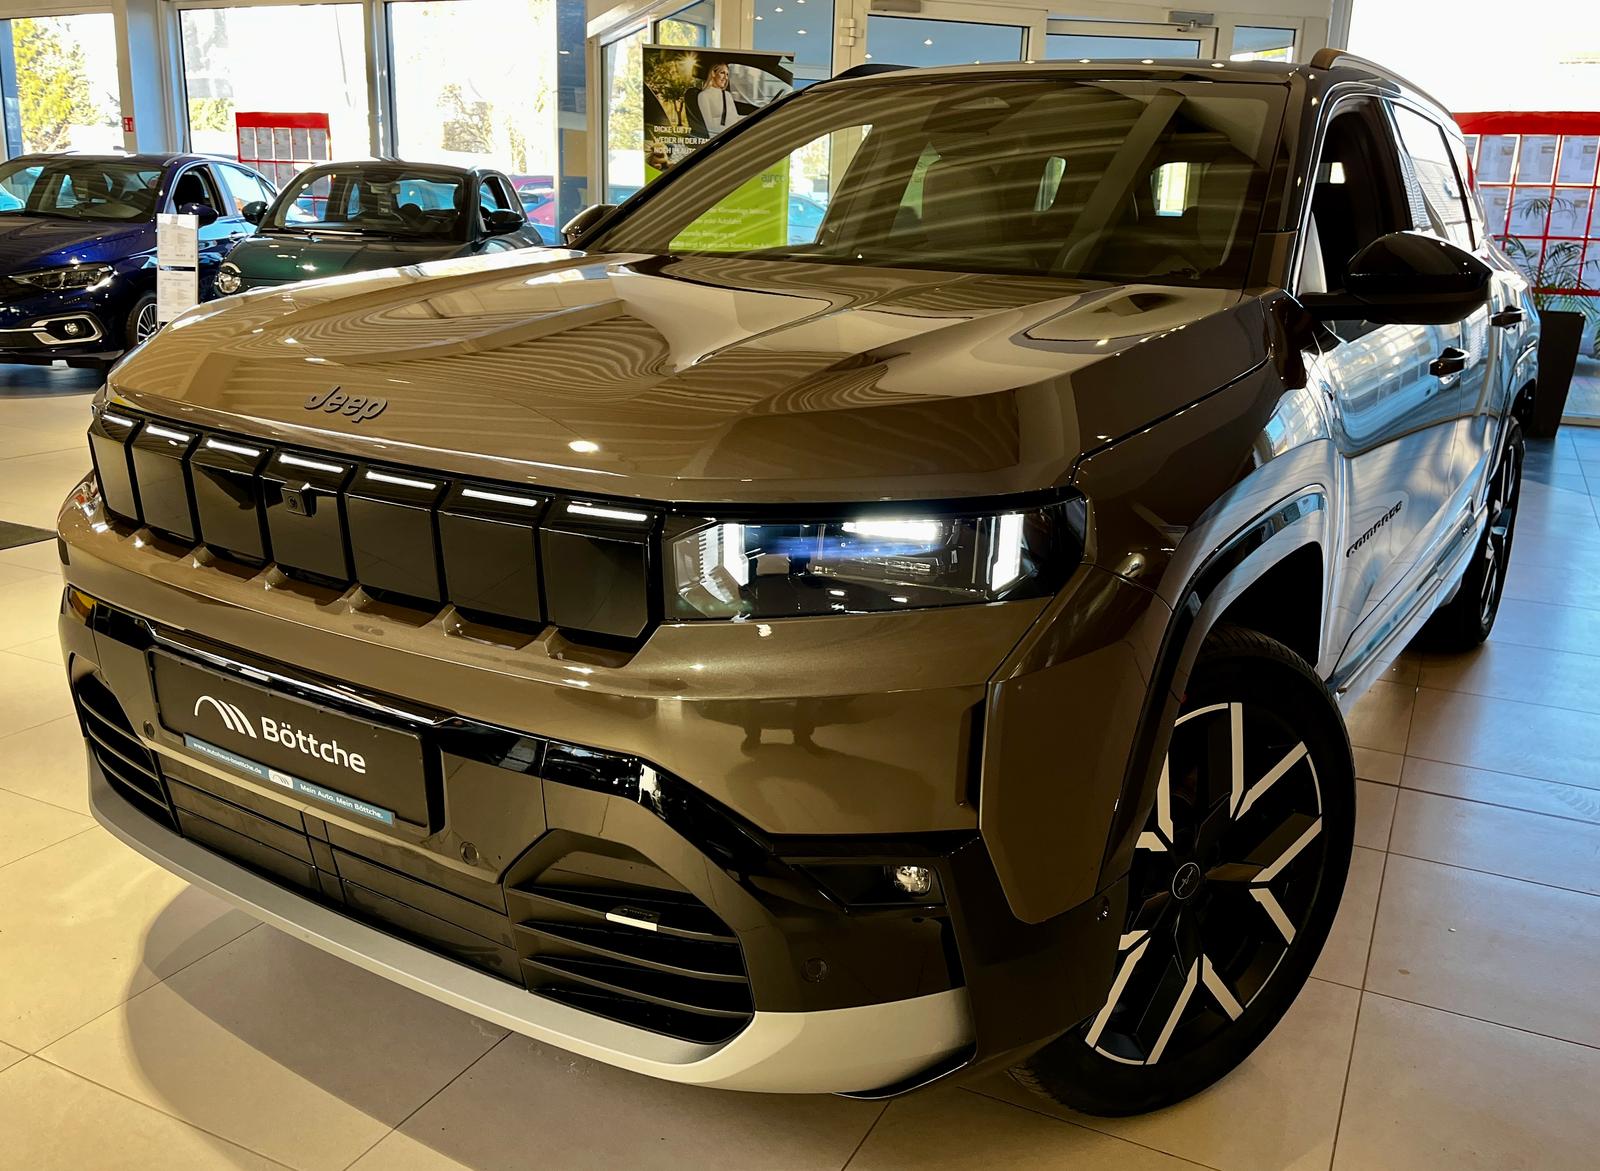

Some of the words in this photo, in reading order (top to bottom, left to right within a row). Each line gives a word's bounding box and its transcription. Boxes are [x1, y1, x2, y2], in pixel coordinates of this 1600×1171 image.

[654, 125, 672, 133] DICKE
[655, 136, 677, 144] WEDER
[685, 137, 697, 145] DER
[304, 384, 388, 423] Jeep
[260, 716, 366, 774] Böttche
[299, 783, 317, 795] Mein
[317, 790, 335, 802] Auto.
[336, 797, 353, 808] Mein
[353, 803, 384, 819] Böttche.
